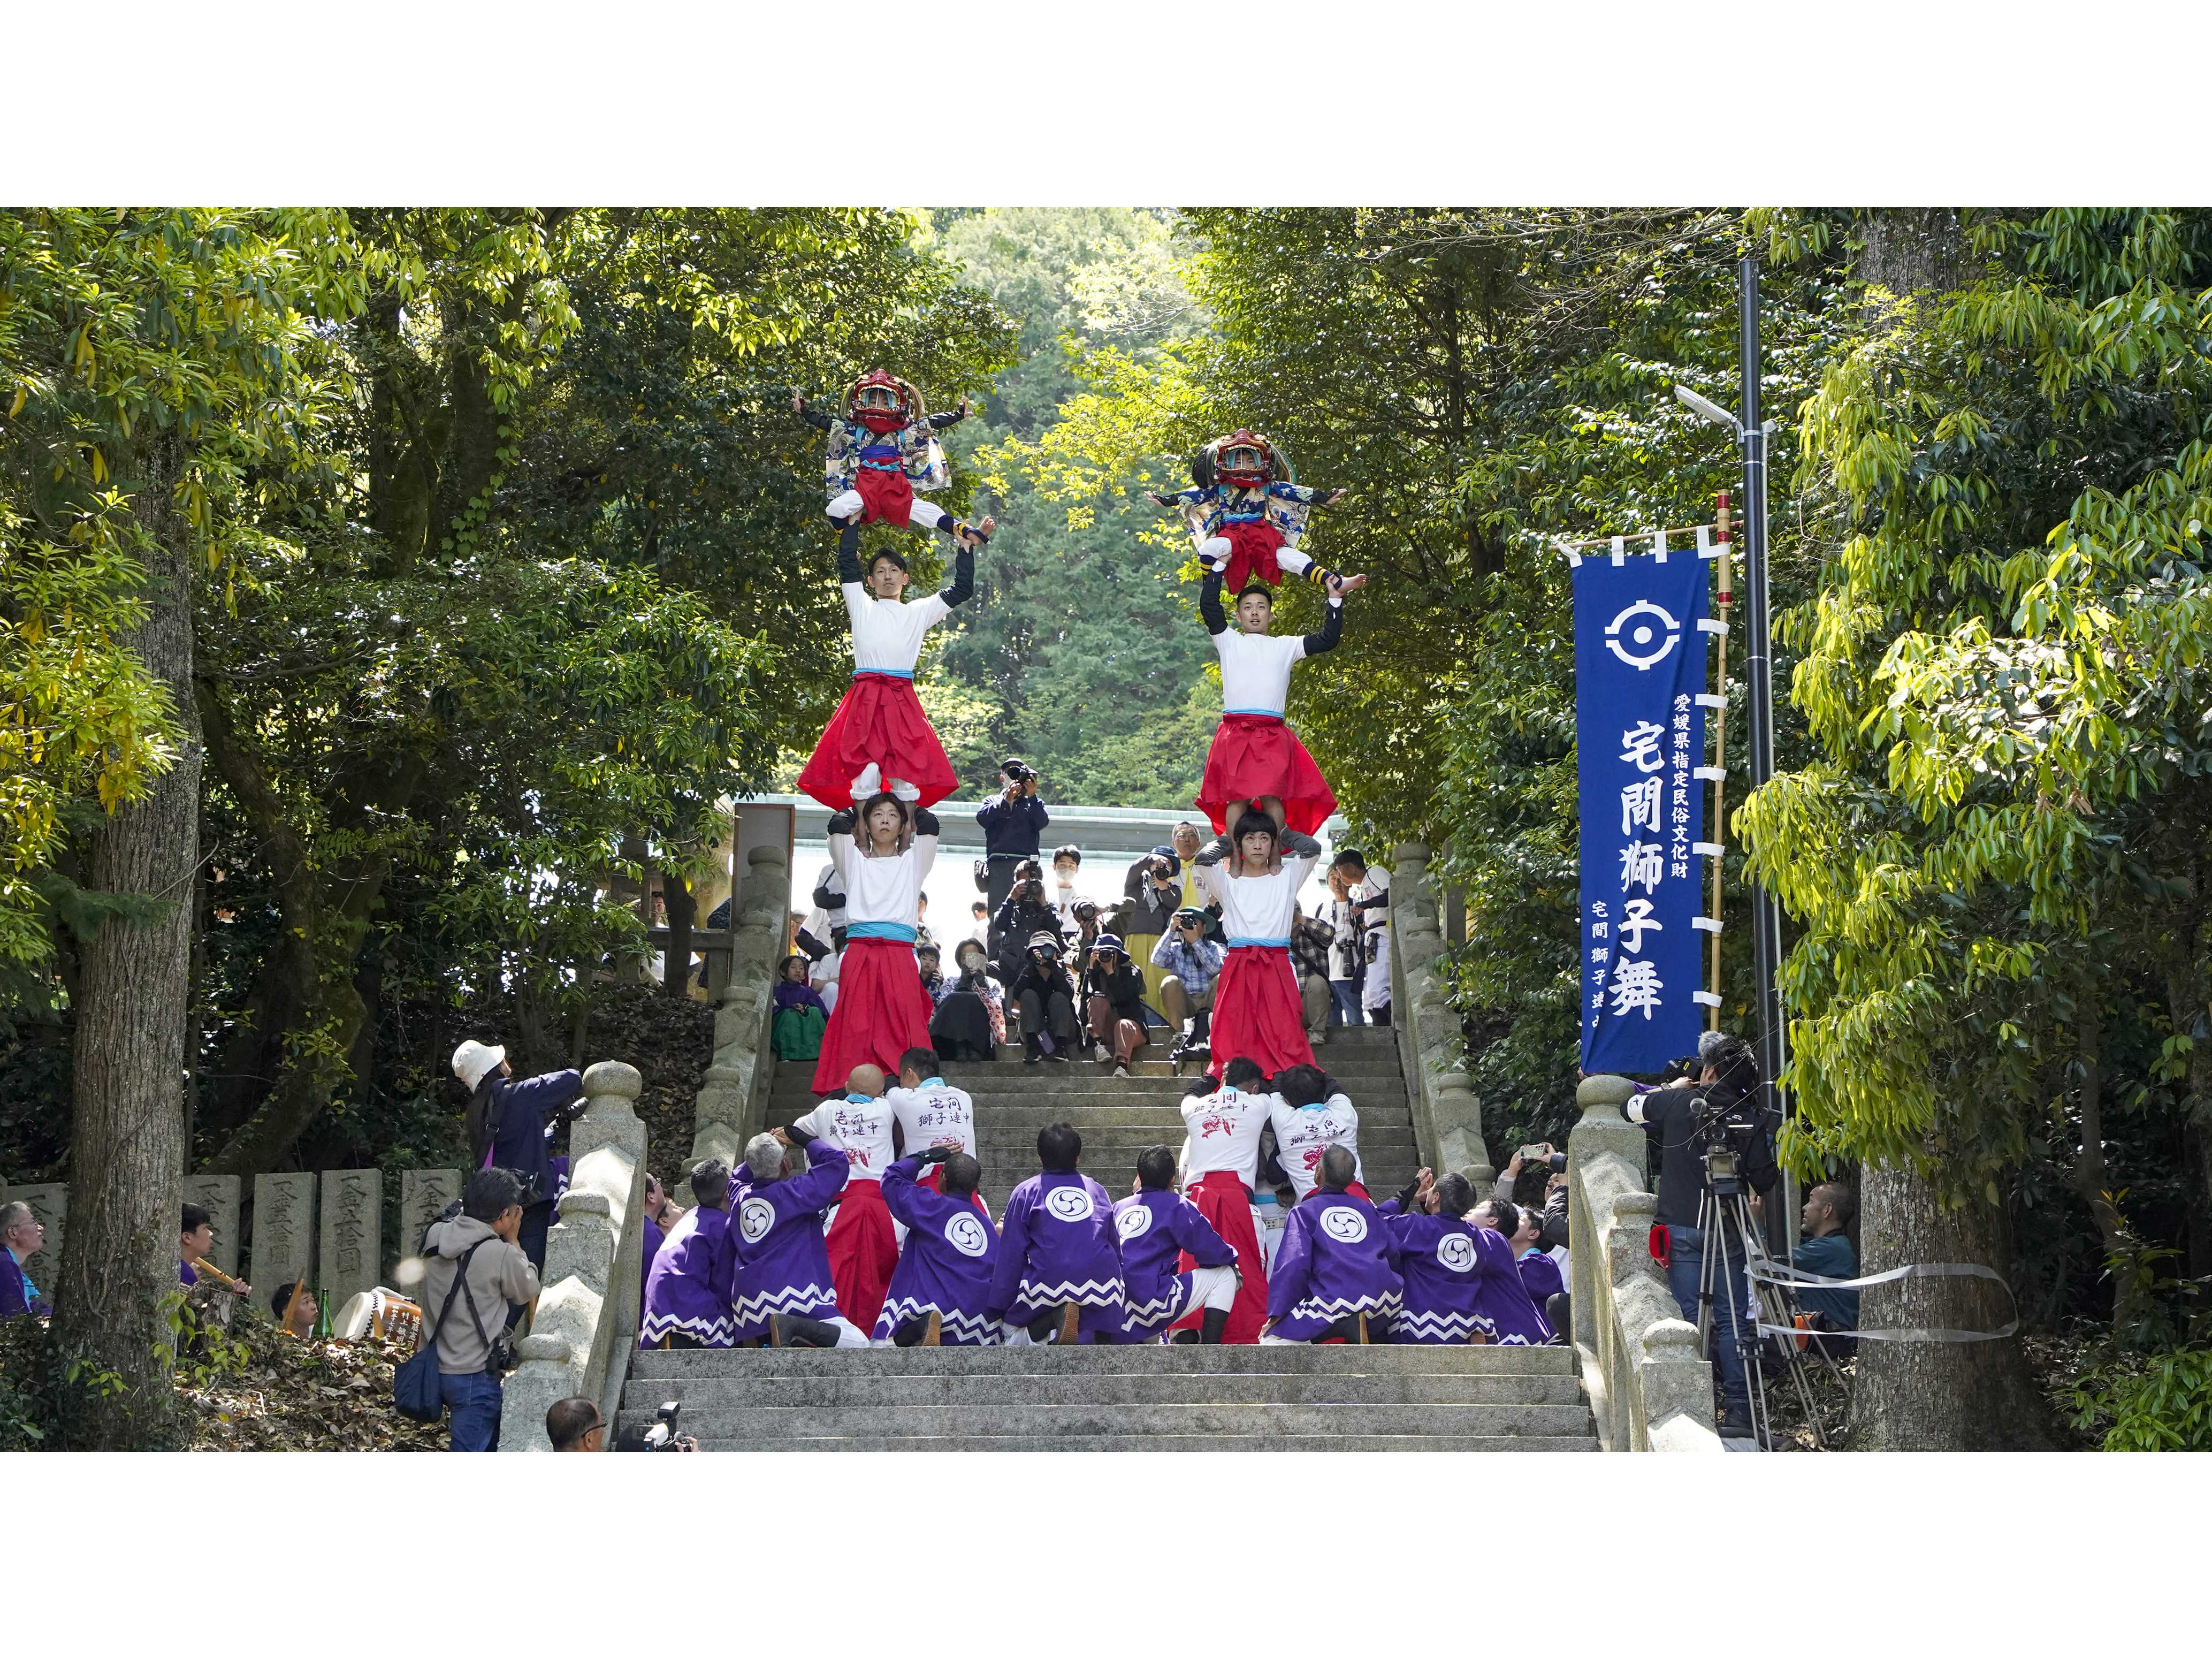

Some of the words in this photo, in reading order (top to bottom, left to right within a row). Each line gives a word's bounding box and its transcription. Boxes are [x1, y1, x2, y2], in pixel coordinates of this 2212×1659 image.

[1607, 720, 1666, 1021] 宅間獅子舞
[1671, 693, 1691, 879] 愛媛県指定民俗文化財
[918, 1112, 970, 1127] 獅子連中
